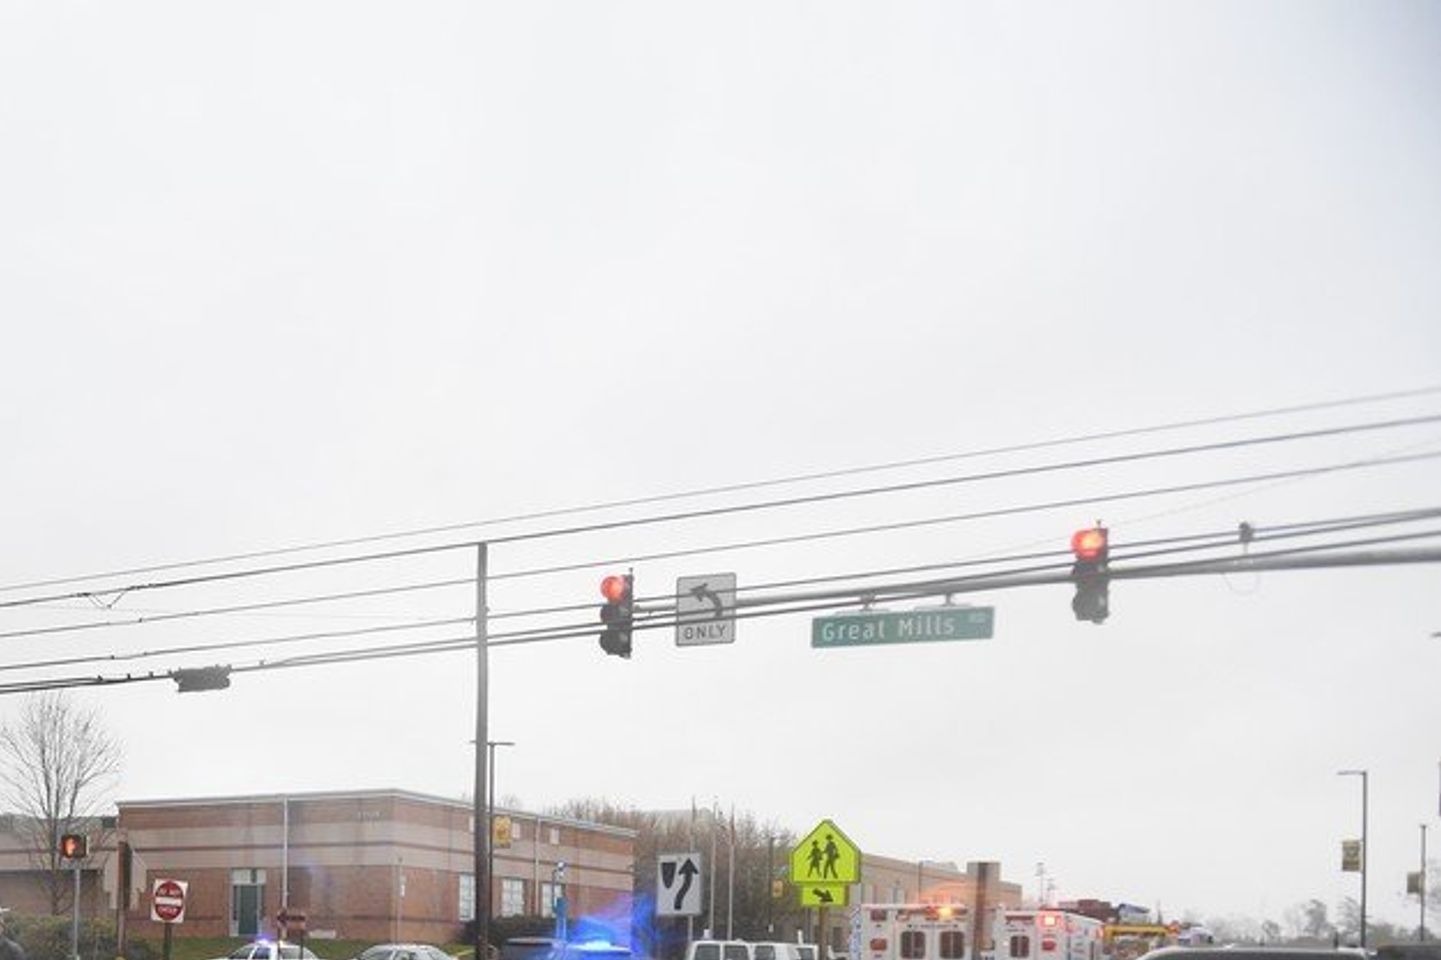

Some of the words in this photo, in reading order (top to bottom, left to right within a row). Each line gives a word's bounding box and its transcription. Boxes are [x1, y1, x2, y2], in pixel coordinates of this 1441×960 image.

[683, 624, 727, 640] ONLY
[822, 620, 885, 640] Great
[898, 616, 956, 637] Mills
